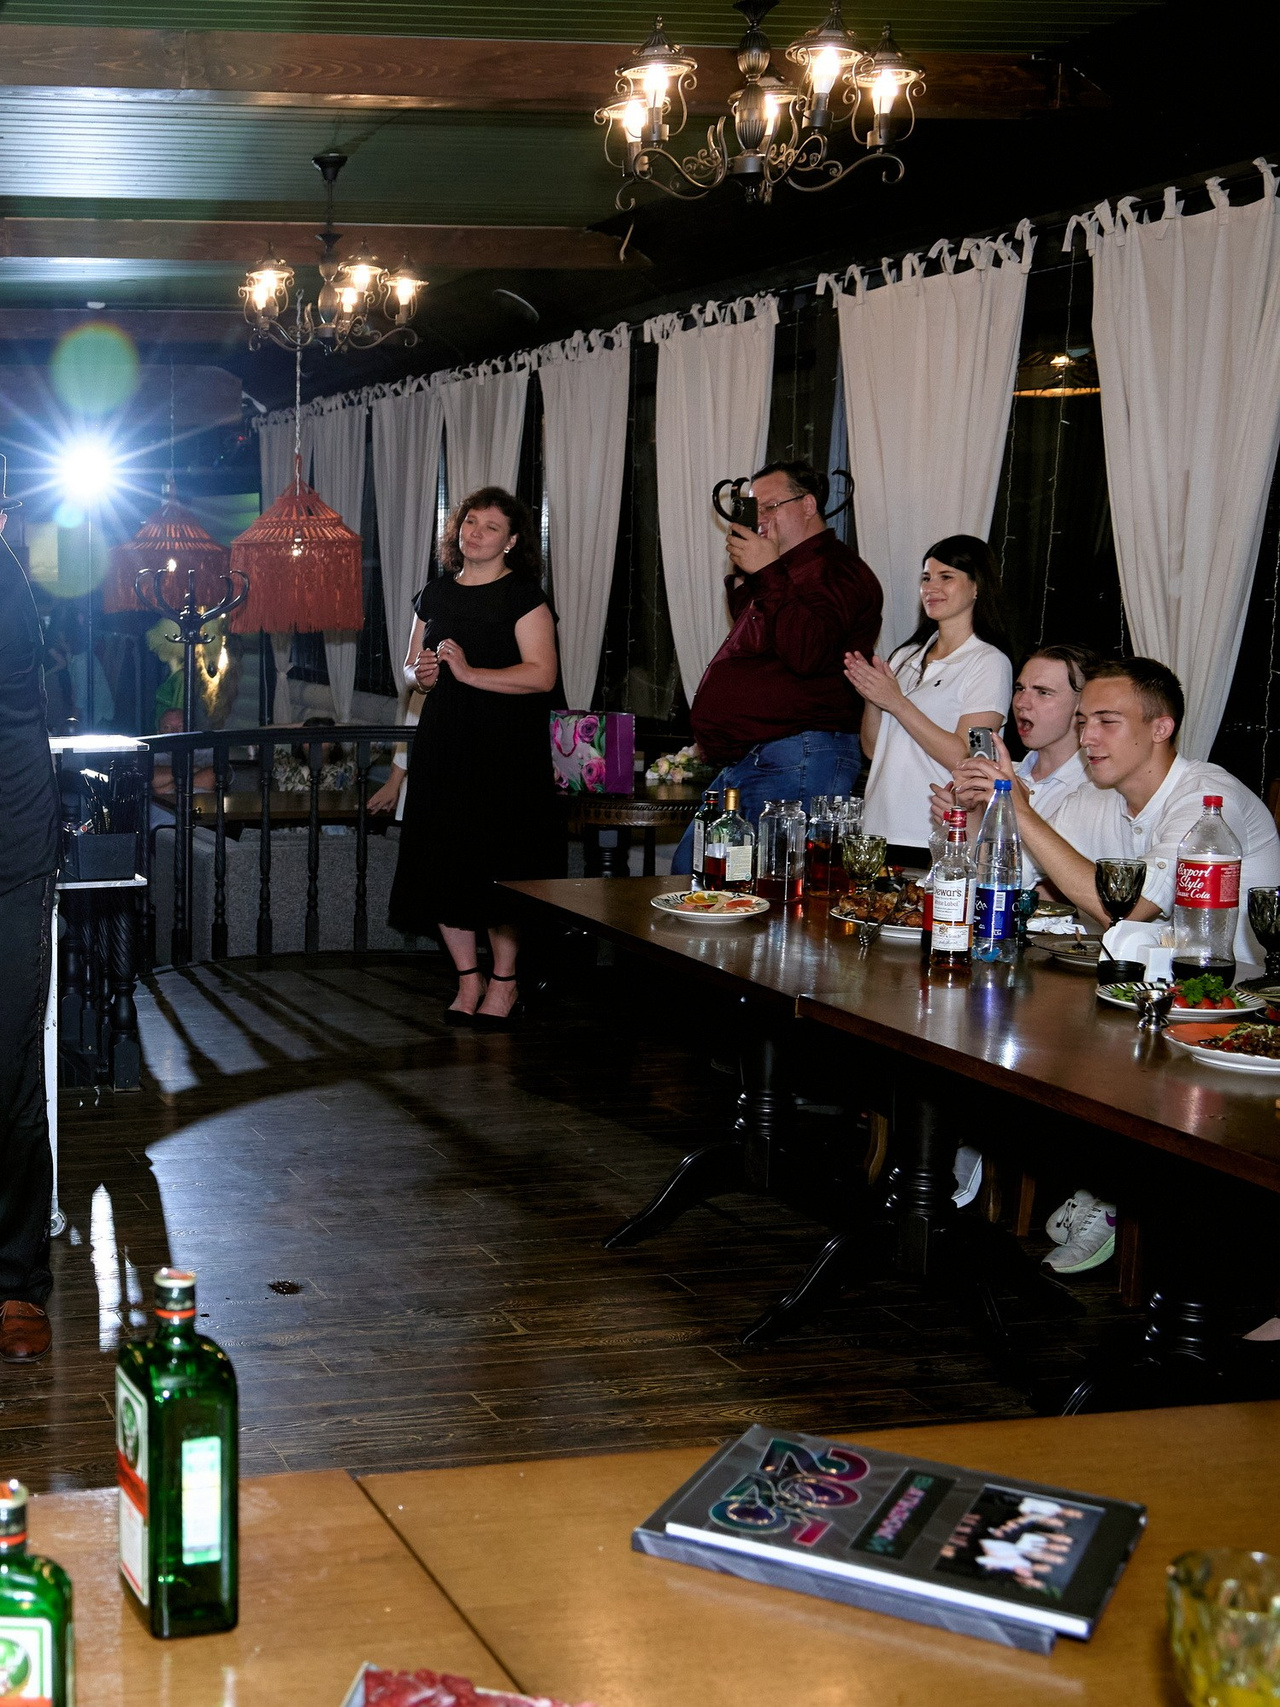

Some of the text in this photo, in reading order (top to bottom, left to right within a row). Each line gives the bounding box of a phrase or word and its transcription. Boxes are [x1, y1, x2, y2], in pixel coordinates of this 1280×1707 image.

[1178, 863, 1213, 877] Export
[1179, 876, 1204, 891] Style
[1190, 889, 1210, 898] Cola
